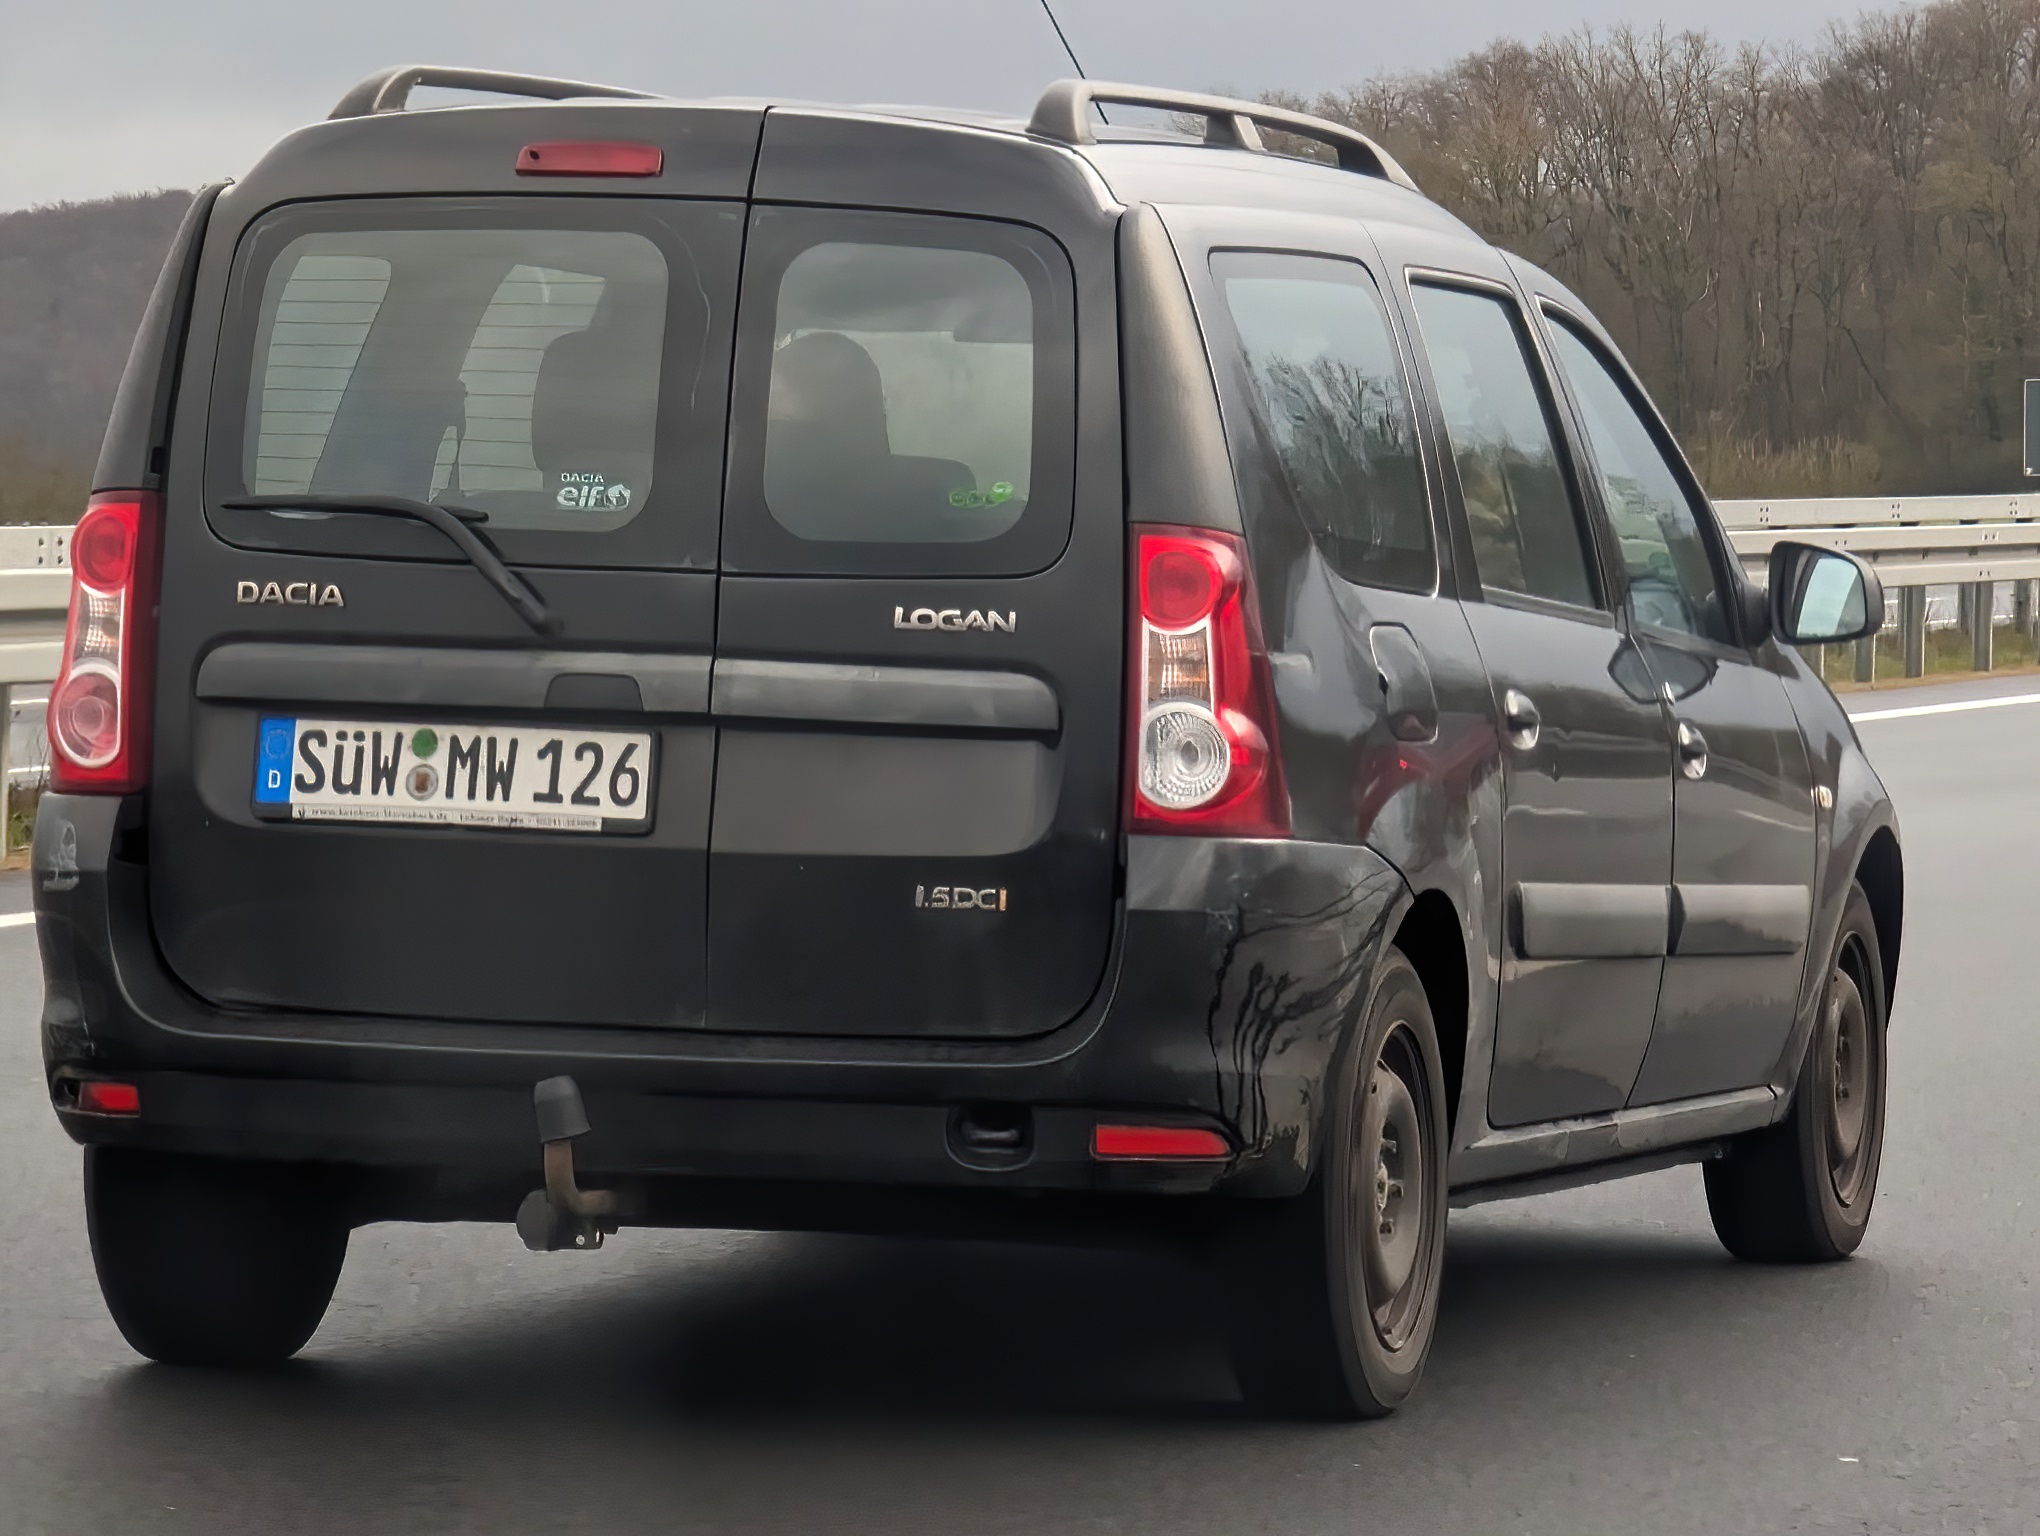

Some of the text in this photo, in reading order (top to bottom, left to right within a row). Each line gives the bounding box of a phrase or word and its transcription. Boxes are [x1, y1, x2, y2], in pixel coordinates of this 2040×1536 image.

[561, 472, 604, 483] DACIA
[557, 485, 604, 507] elf
[237, 581, 344, 607] DACIA
[894, 605, 1016, 633] LOGAN
[268, 769, 281, 789] D
[294, 729, 639, 807] SÜW MW 126
